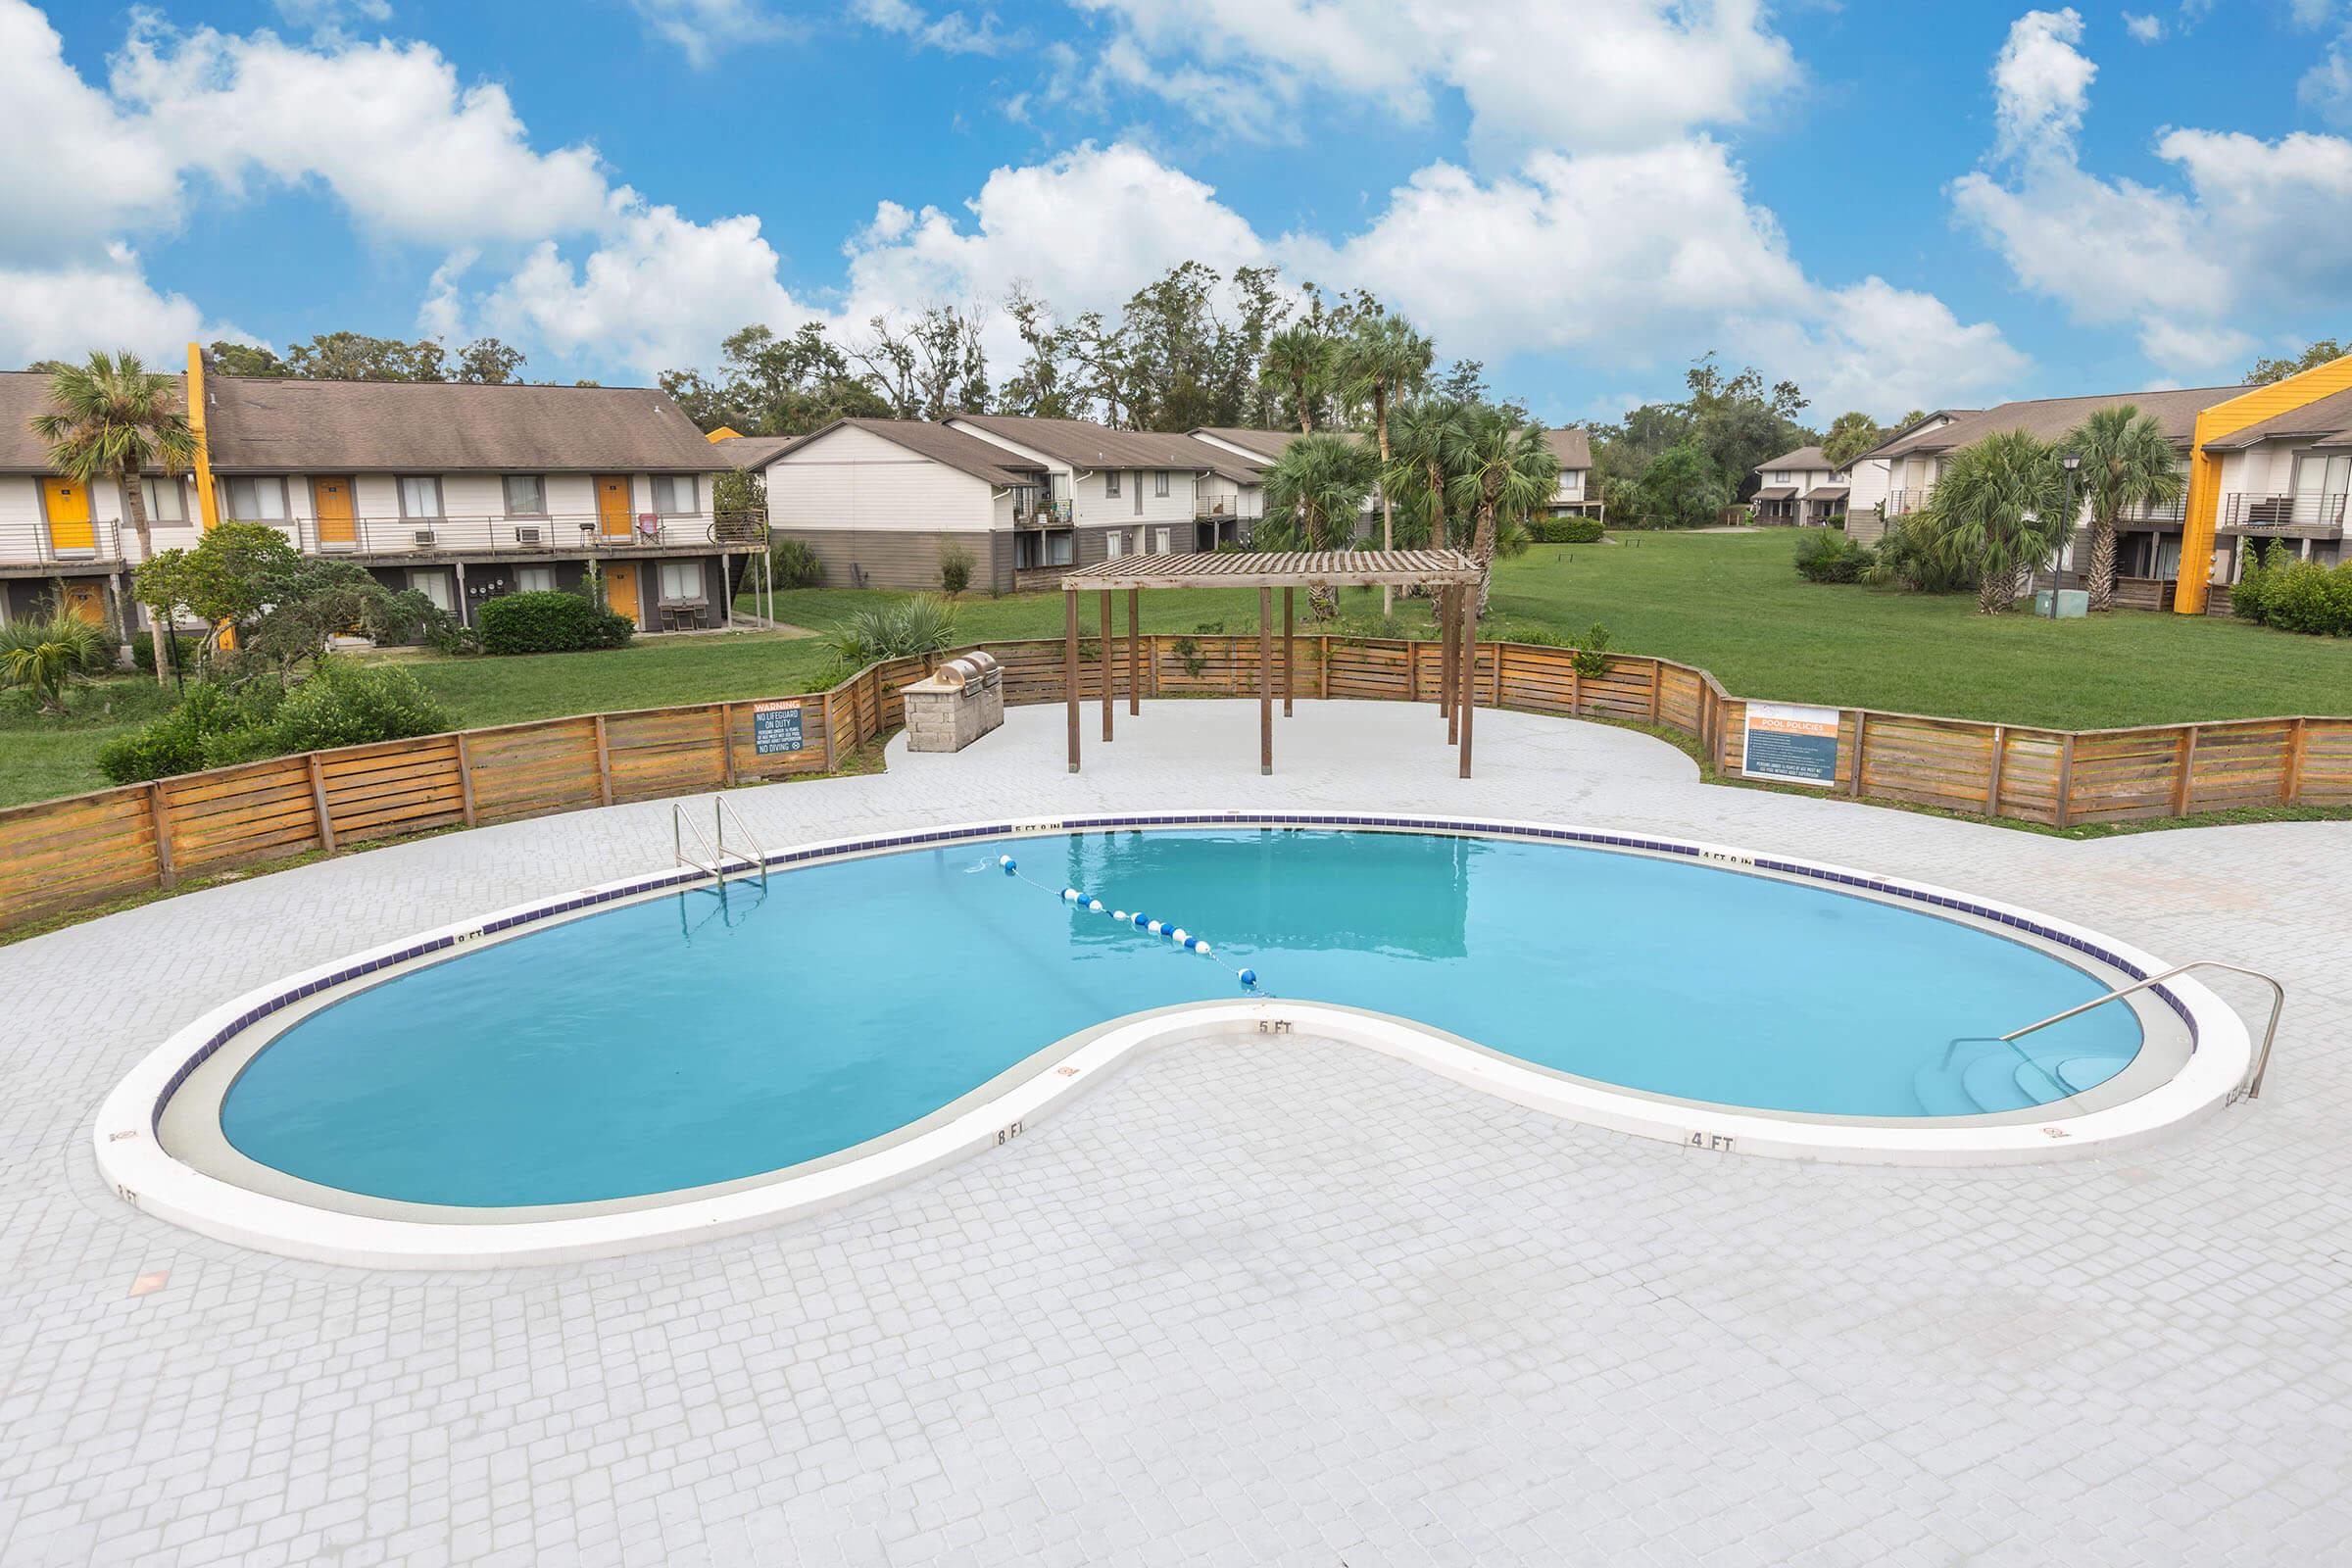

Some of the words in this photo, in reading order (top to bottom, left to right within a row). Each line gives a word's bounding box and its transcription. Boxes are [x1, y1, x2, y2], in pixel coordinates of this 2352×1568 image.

[755, 700, 801, 712] WARNING
[757, 712, 765, 721] NO
[766, 710, 799, 720] LIFEGUARD
[765, 720, 774, 729] ON
[775, 718, 790, 728] DUTY
[1762, 719, 1785, 728] POOL
[1787, 720, 1823, 731] POLICIES
[760, 745, 768, 754] NO
[769, 743, 790, 753] DIVING
[1259, 1020, 1268, 1034] 5
[1275, 1020, 1292, 1034] FT
[998, 1130, 1005, 1146] 8
[1010, 1121, 1024, 1139] FT
[1691, 1132, 1702, 1146] 4
[1712, 1135, 1733, 1152] FT
